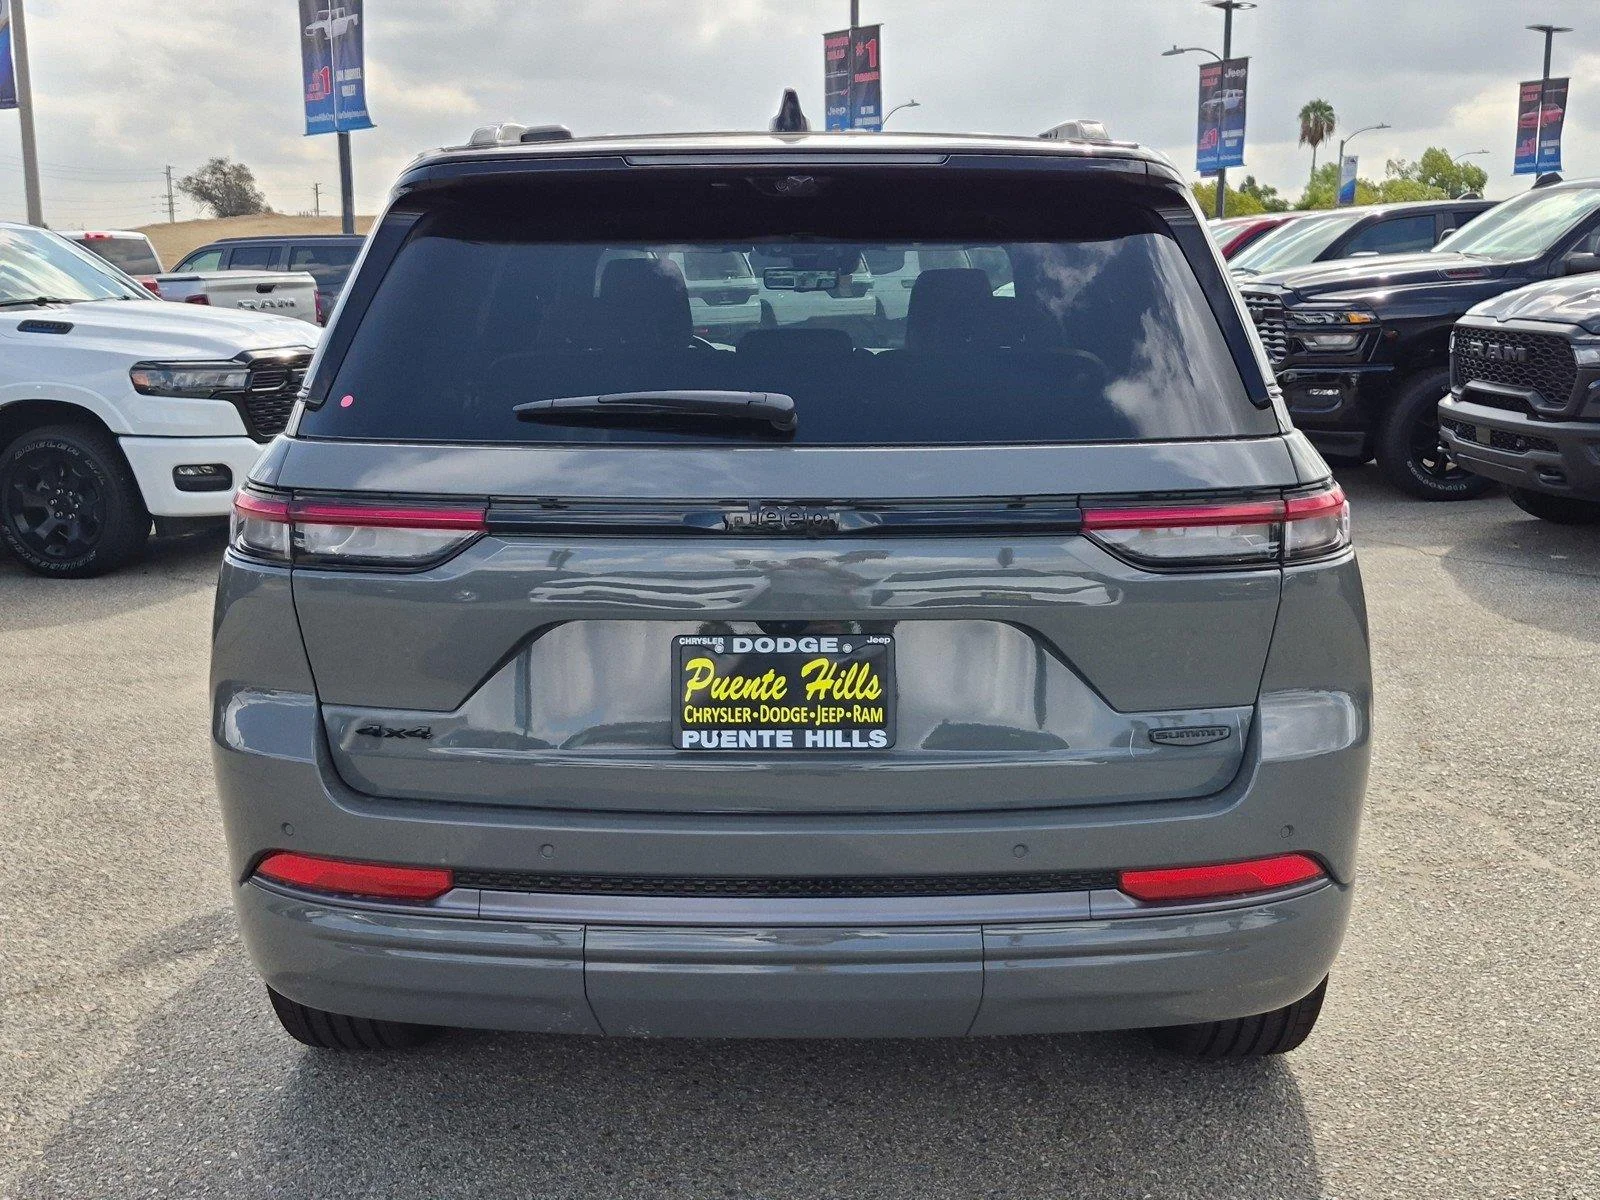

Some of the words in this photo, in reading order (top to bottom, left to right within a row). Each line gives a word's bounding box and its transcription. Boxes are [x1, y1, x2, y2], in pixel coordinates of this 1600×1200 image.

[828, 105, 846, 116] Jeep
[237, 298, 297, 311] RAM
[1469, 340, 1528, 362] RAM
[679, 637, 724, 646] CHRYSLER
[733, 637, 839, 653] DODGE
[867, 636, 891, 645] Jeep
[685, 657, 788, 702] Puente
[801, 657, 882, 701] Hills
[682, 729, 794, 748] PUENTE
[805, 729, 888, 748] HILLS
[1154, 728, 1227, 740] SUMMIT
